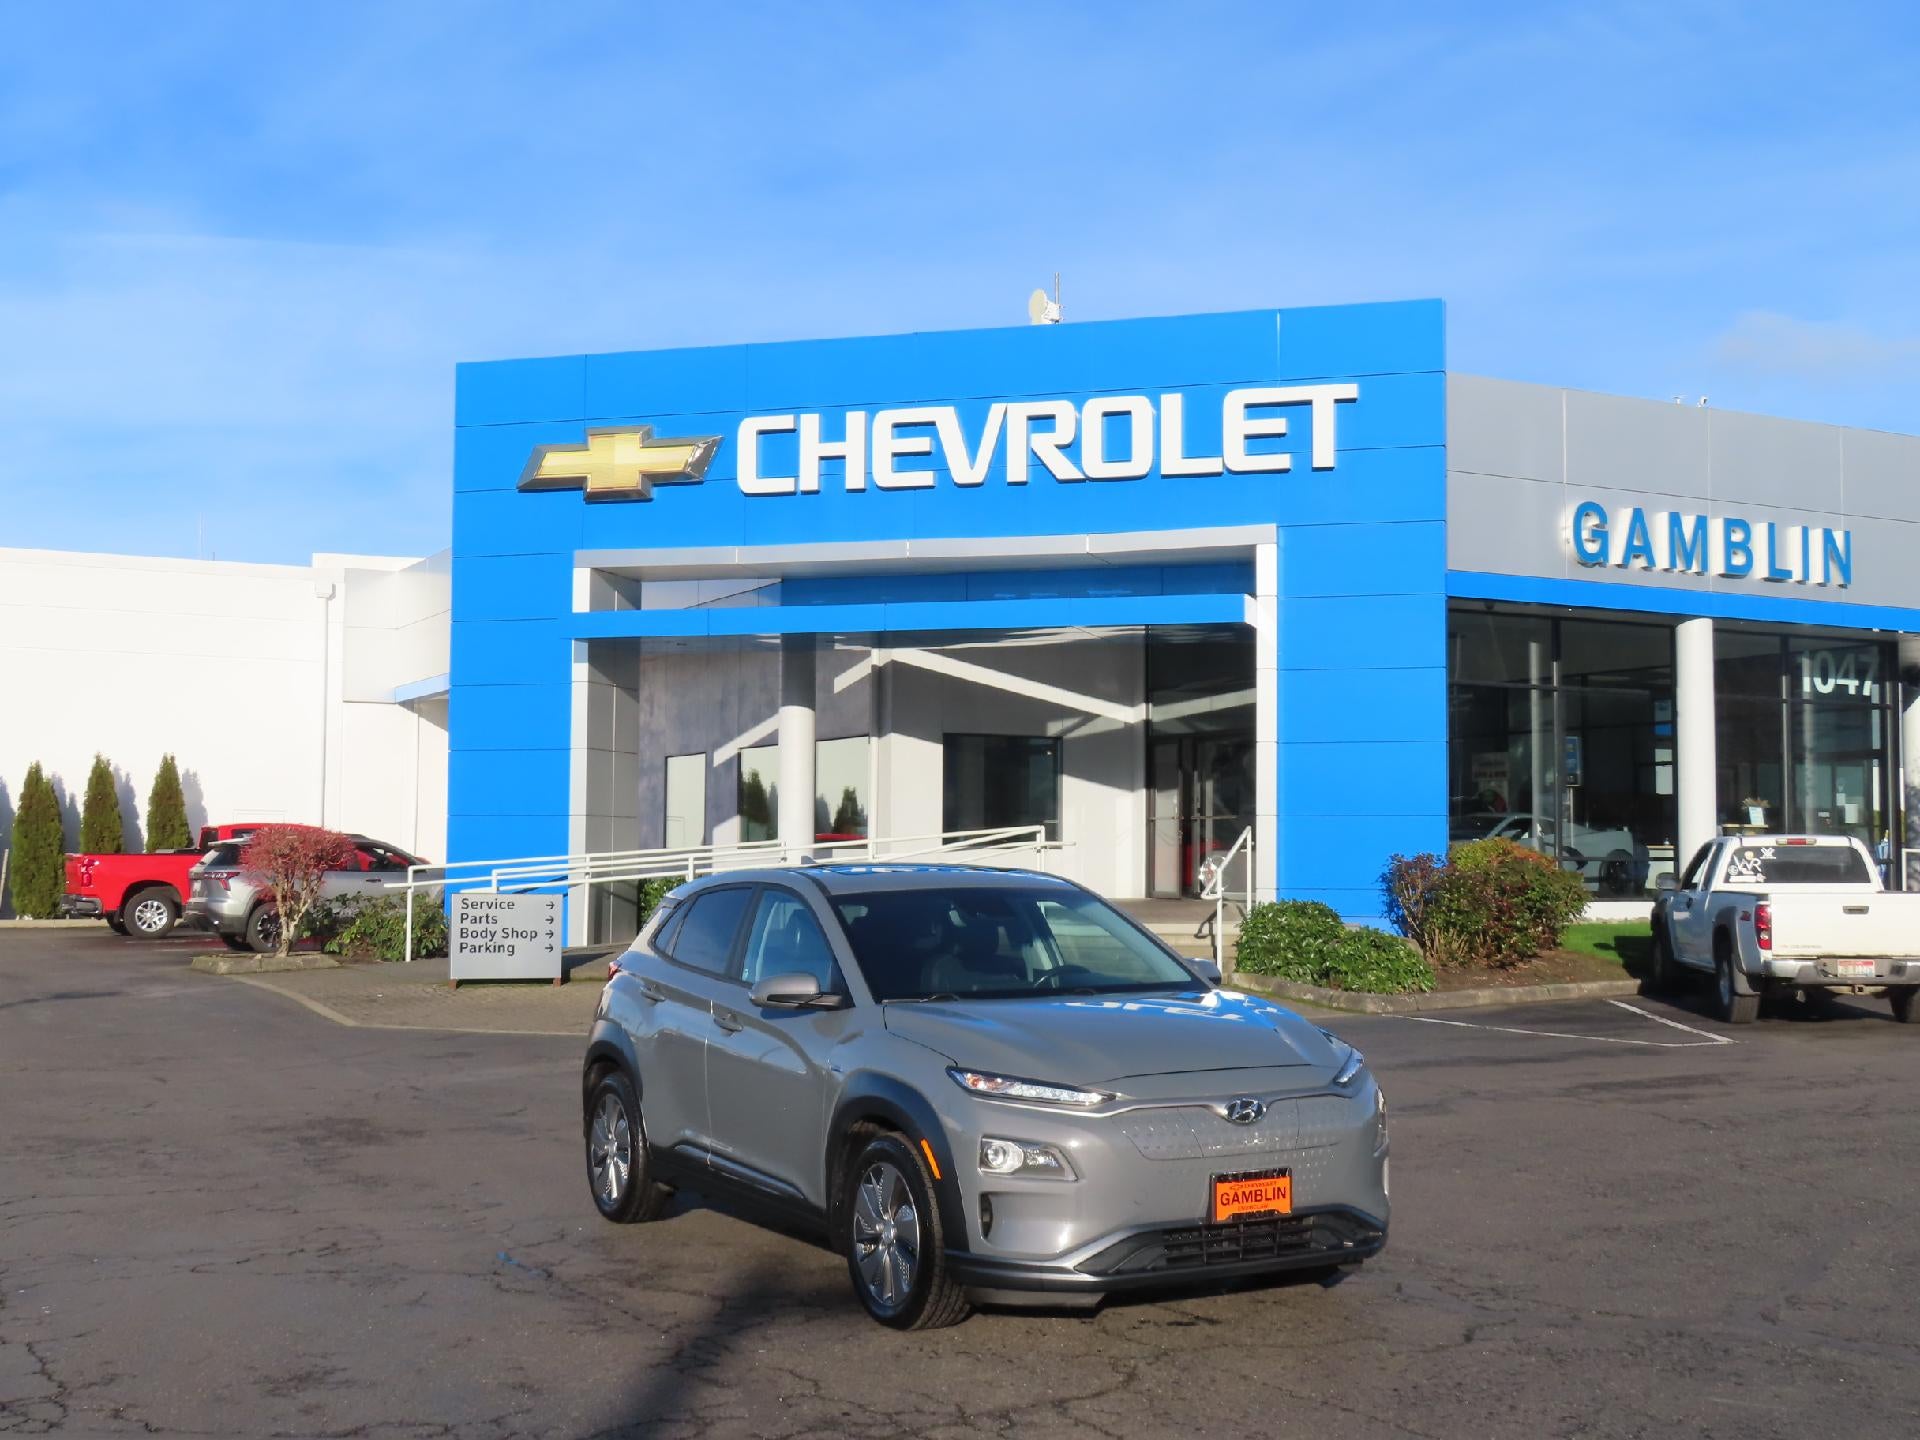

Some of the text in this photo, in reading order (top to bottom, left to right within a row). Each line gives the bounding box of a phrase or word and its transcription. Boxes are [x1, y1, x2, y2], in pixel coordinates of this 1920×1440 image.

[737, 383, 1359, 496] CHEVROLET
[1572, 501, 1852, 587] GAMBLIN
[1797, 650, 1878, 696] 1047
[461, 898, 515, 910] Service
[460, 913, 498, 925] Parts
[460, 928, 538, 942] Body Shop
[459, 942, 516, 957] Parking
[1220, 1187, 1287, 1207] GAMBLIN
